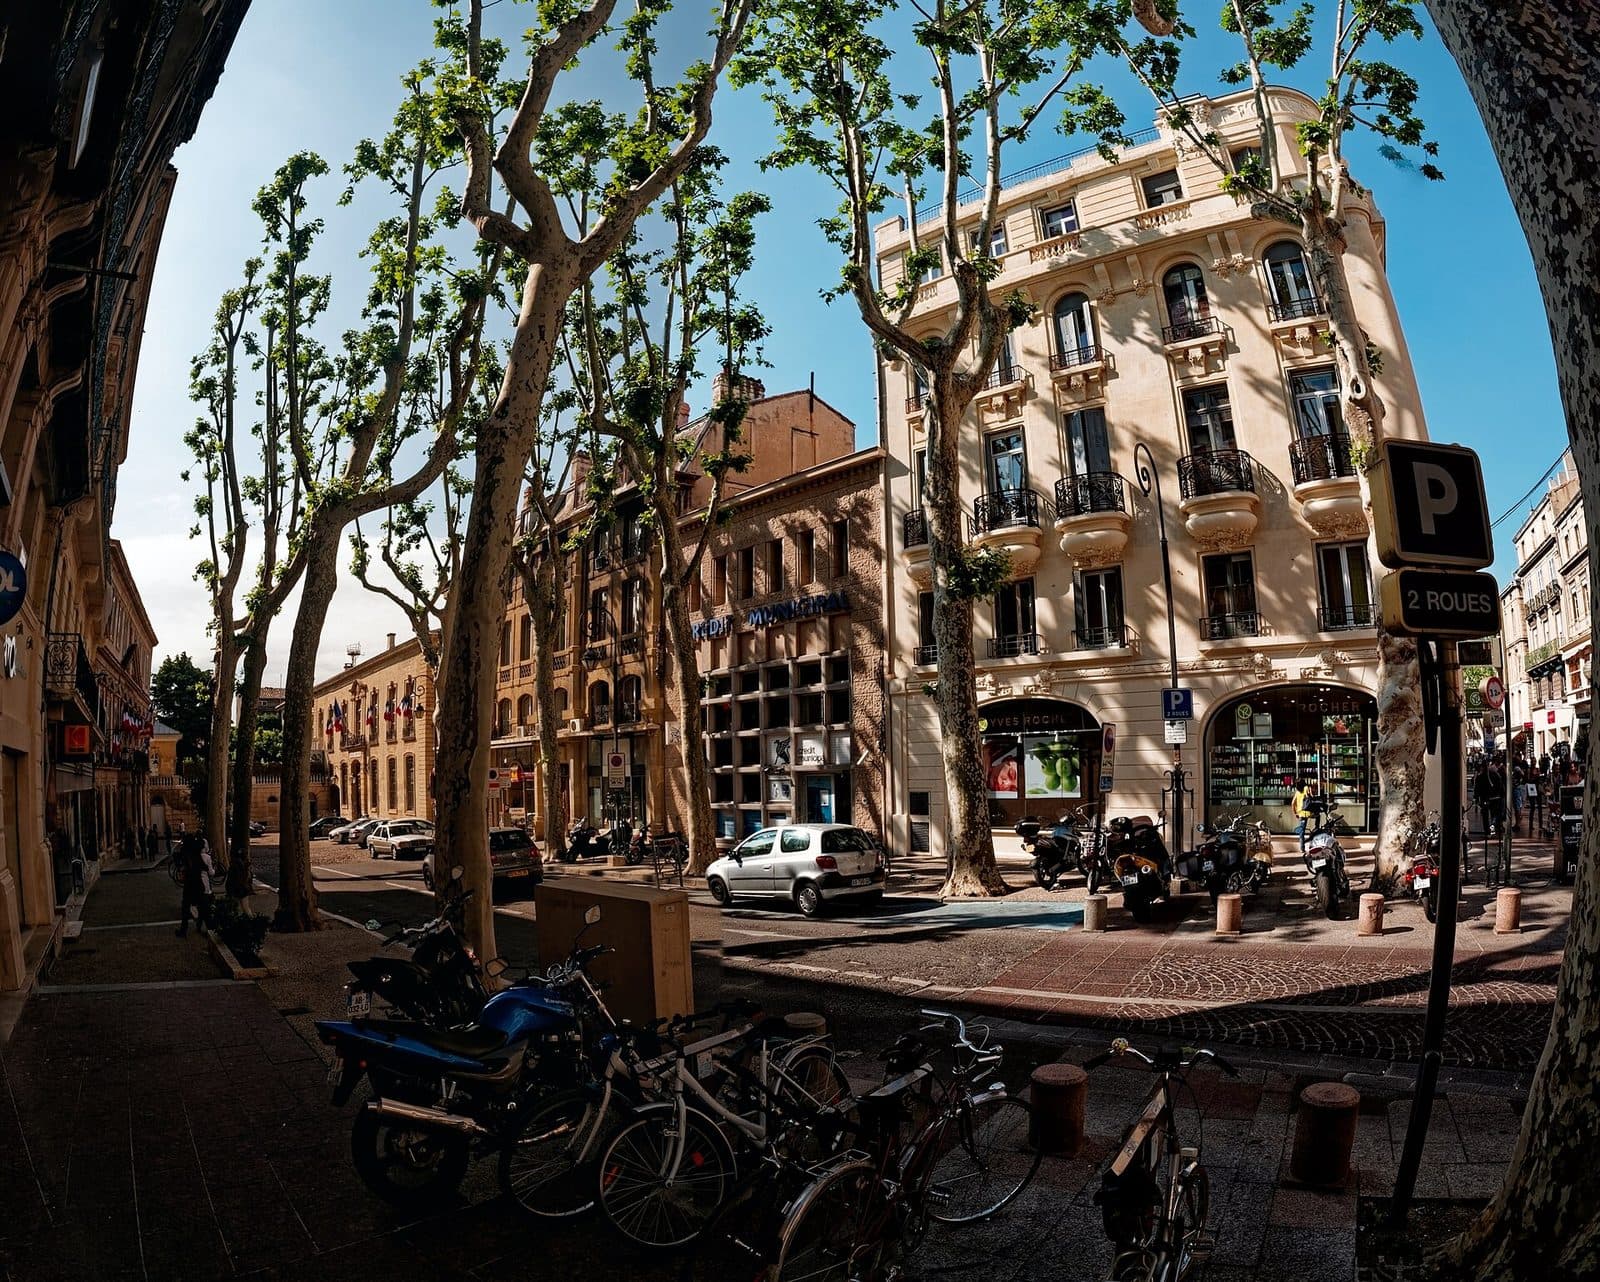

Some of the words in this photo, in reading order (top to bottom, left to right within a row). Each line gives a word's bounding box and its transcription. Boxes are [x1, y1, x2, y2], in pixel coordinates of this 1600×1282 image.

[1412, 461, 1458, 536] P
[1407, 590, 1420, 609] 2
[1426, 590, 1492, 613] ROUES
[691, 615, 735, 640] REDIT
[748, 591, 850, 626] MUNICIPAL
[1170, 691, 1184, 710] P
[1299, 701, 1360, 713] ROCHER
[990, 716, 1020, 727] YVES
